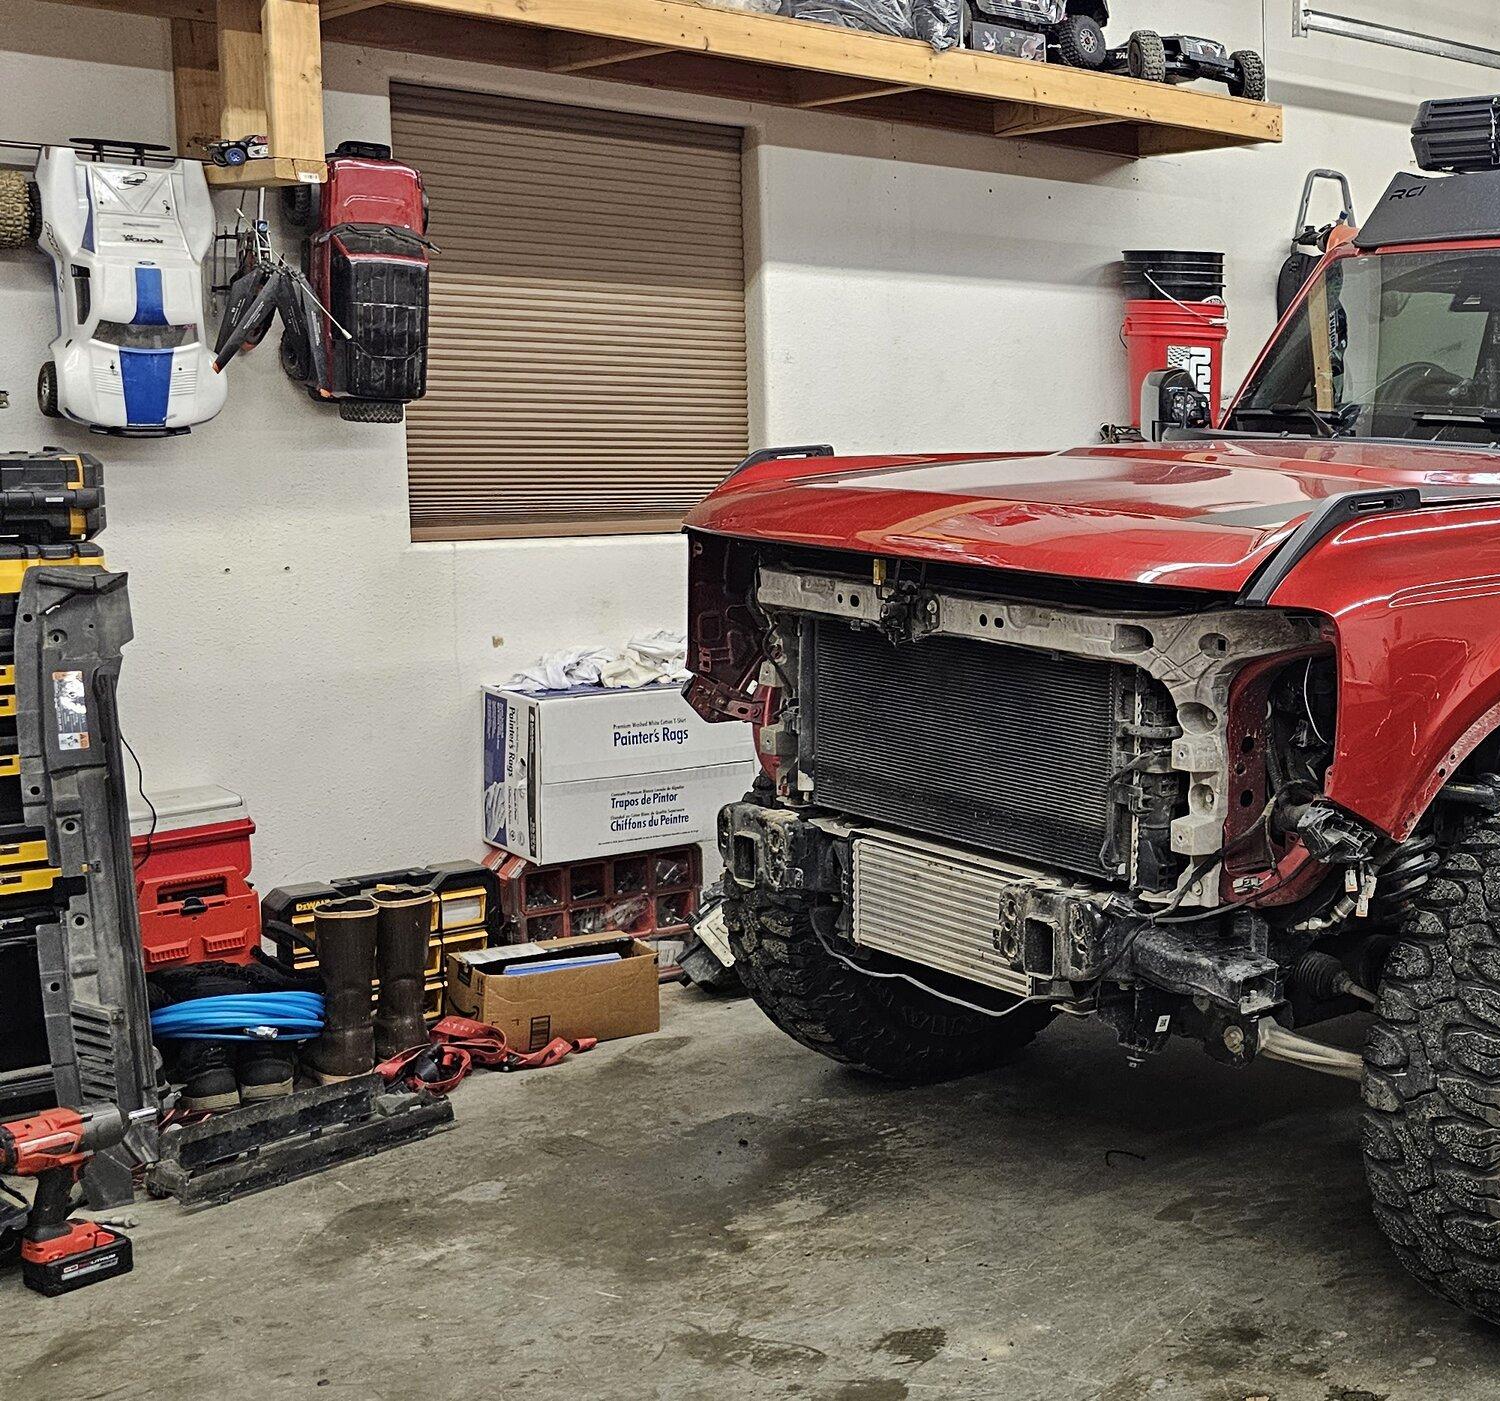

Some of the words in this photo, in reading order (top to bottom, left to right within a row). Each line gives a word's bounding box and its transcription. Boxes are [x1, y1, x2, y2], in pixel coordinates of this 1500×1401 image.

[1389, 185, 1427, 201] RCI
[613, 729, 660, 747] Painter's
[662, 727, 689, 745] Rags
[506, 752, 516, 777] Rags
[611, 798, 639, 811] Trapos
[641, 794, 652, 806] de
[653, 793, 679, 804] Pintor
[610, 818, 647, 832] Chiffons
[648, 815, 659, 828] du
[660, 814, 690, 826] Peintre
